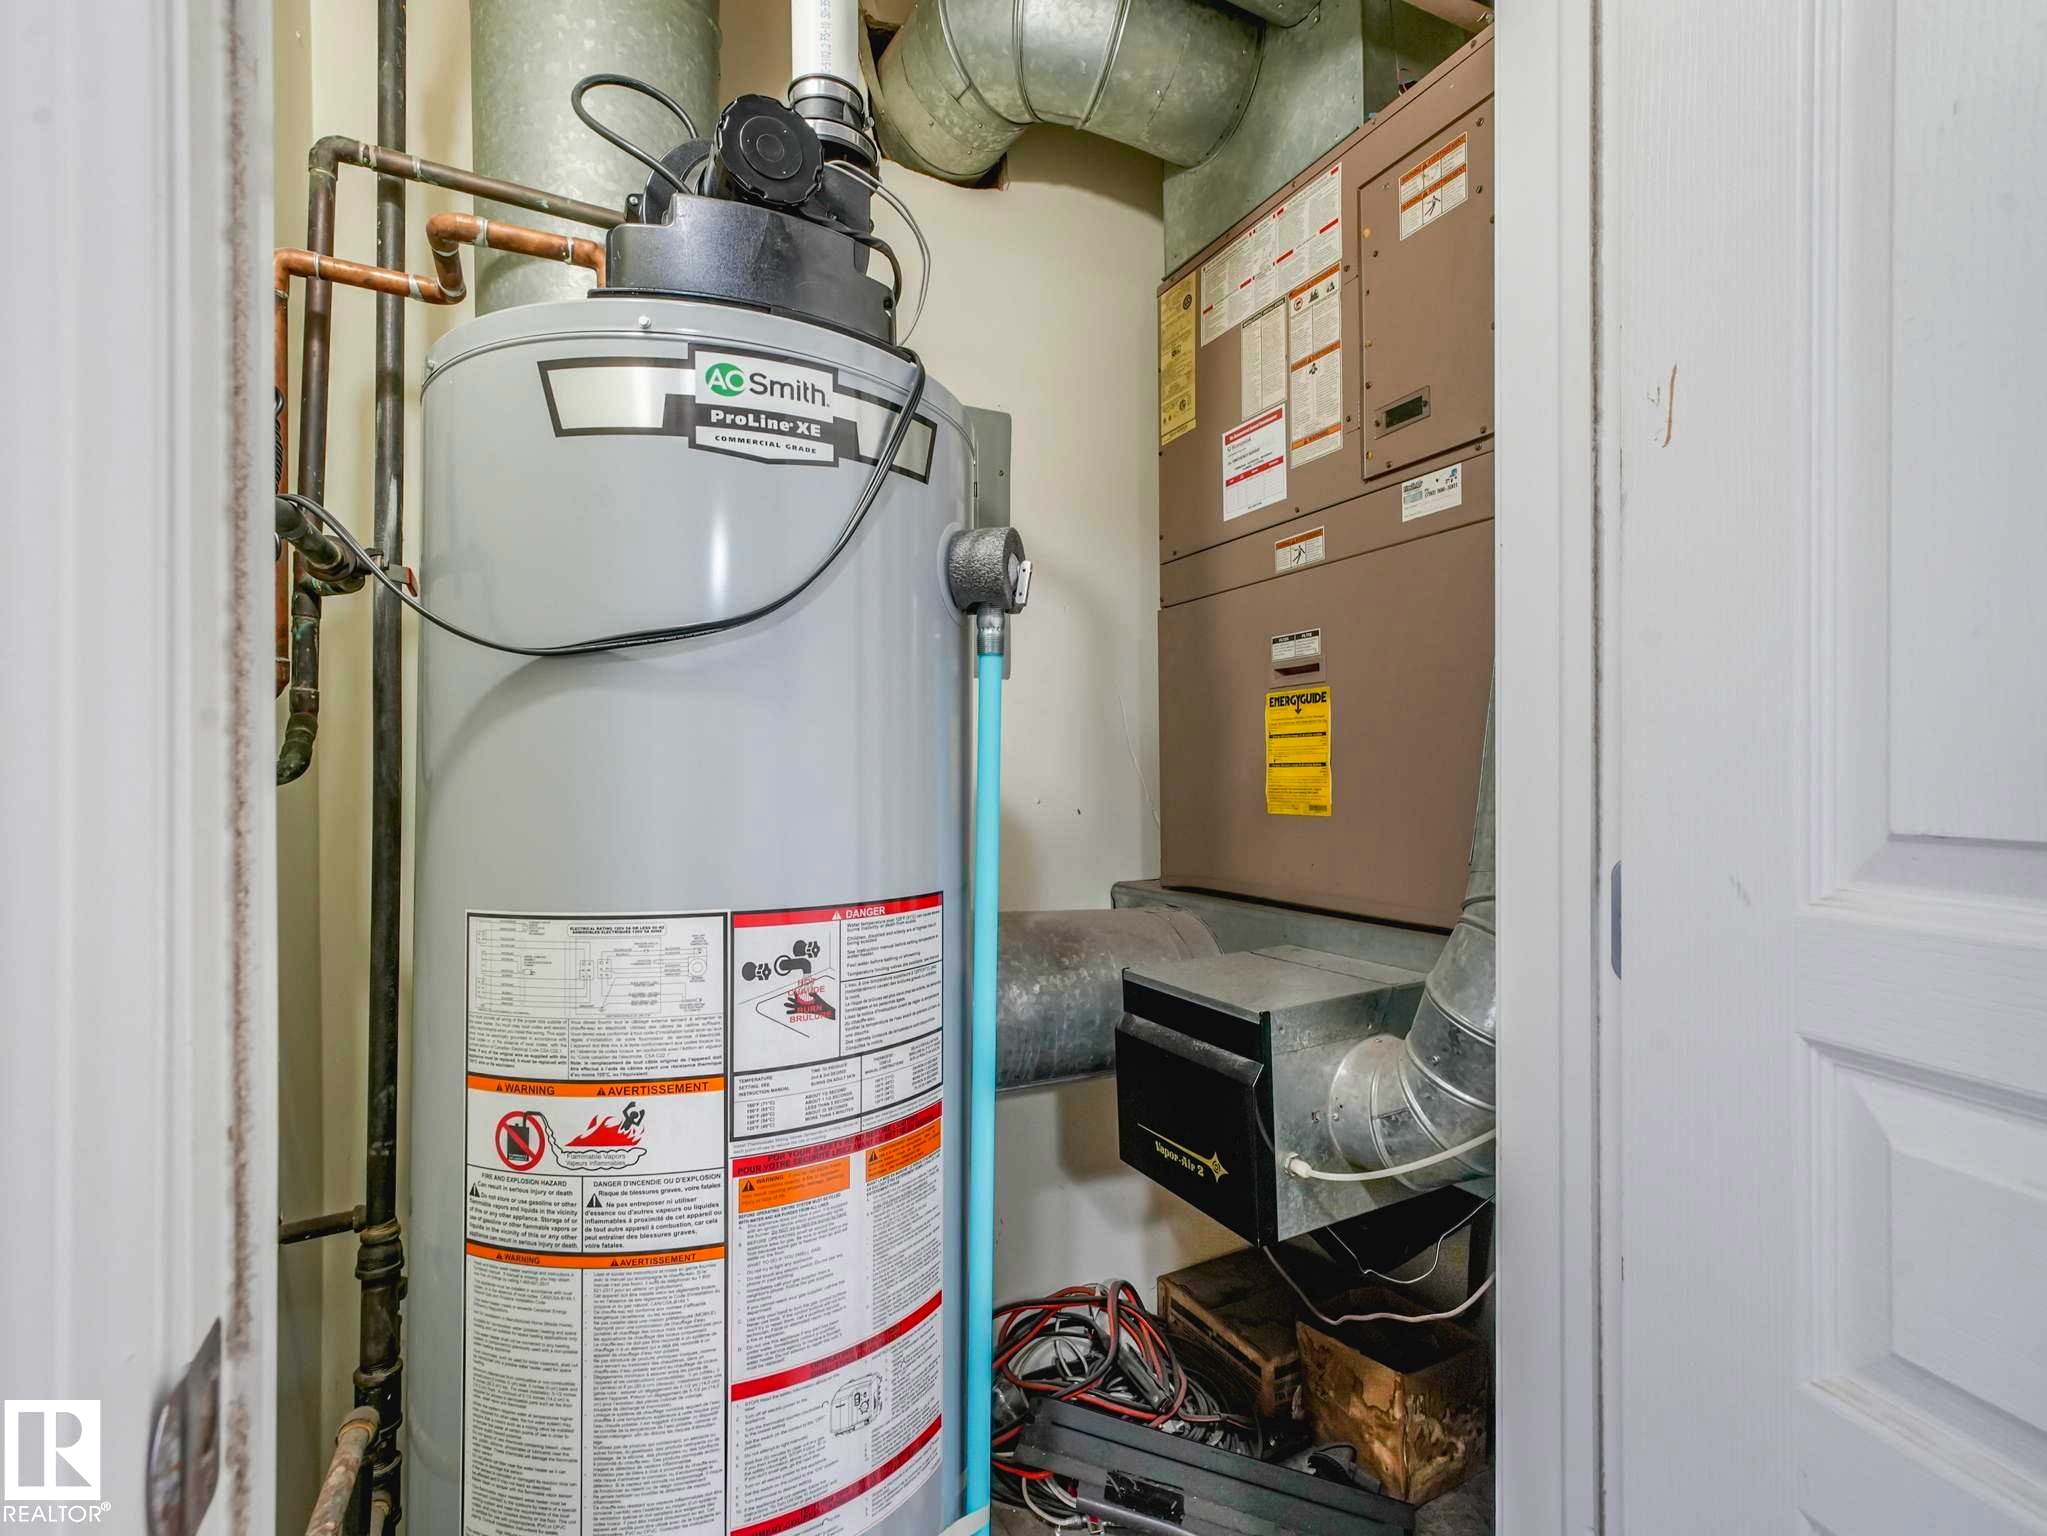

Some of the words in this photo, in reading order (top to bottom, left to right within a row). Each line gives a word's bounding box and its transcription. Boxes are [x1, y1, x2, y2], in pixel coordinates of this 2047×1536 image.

[796, 420, 821, 437] XE
[715, 435, 781, 449] COMMERCIAL
[785, 443, 817, 454] GRADE
[1269, 691, 1327, 708] ENERGYGUIDE
[845, 906, 885, 919] DANGER
[504, 1083, 555, 1096] WARNING
[608, 1082, 709, 1096] AVERTISSEMENT
[1197, 1165, 1204, 1177] 2
[506, 1177, 539, 1185] EXPLOSION
[623, 1178, 662, 1187] D'INCENDIE
[676, 1173, 721, 1184] D'EXPLOSION
[701, 1182, 721, 1190] fatales
[529, 1199, 552, 1207] gasoline
[616, 1201, 628, 1209] pas
[630, 1199, 665, 1208] entreposer
[675, 1196, 697, 1204] utiliser
[656, 1205, 681, 1214] vapeurs
[693, 1202, 719, 1211] liquides
[557, 1209, 578, 1217] vicinity
[686, 1211, 712, 1219] appareil
[540, 1216, 562, 1224] Storage
[625, 1224, 649, 1233] appareil
[705, 1217, 718, 1225] cela
[640, 1230, 671, 1239] blessures
[584, 1241, 600, 1249] voire
[601, 1241, 624, 1249] fatales.
[504, 1253, 540, 1264] WARNING
[620, 1254, 696, 1266] AVERTISSEMENT
